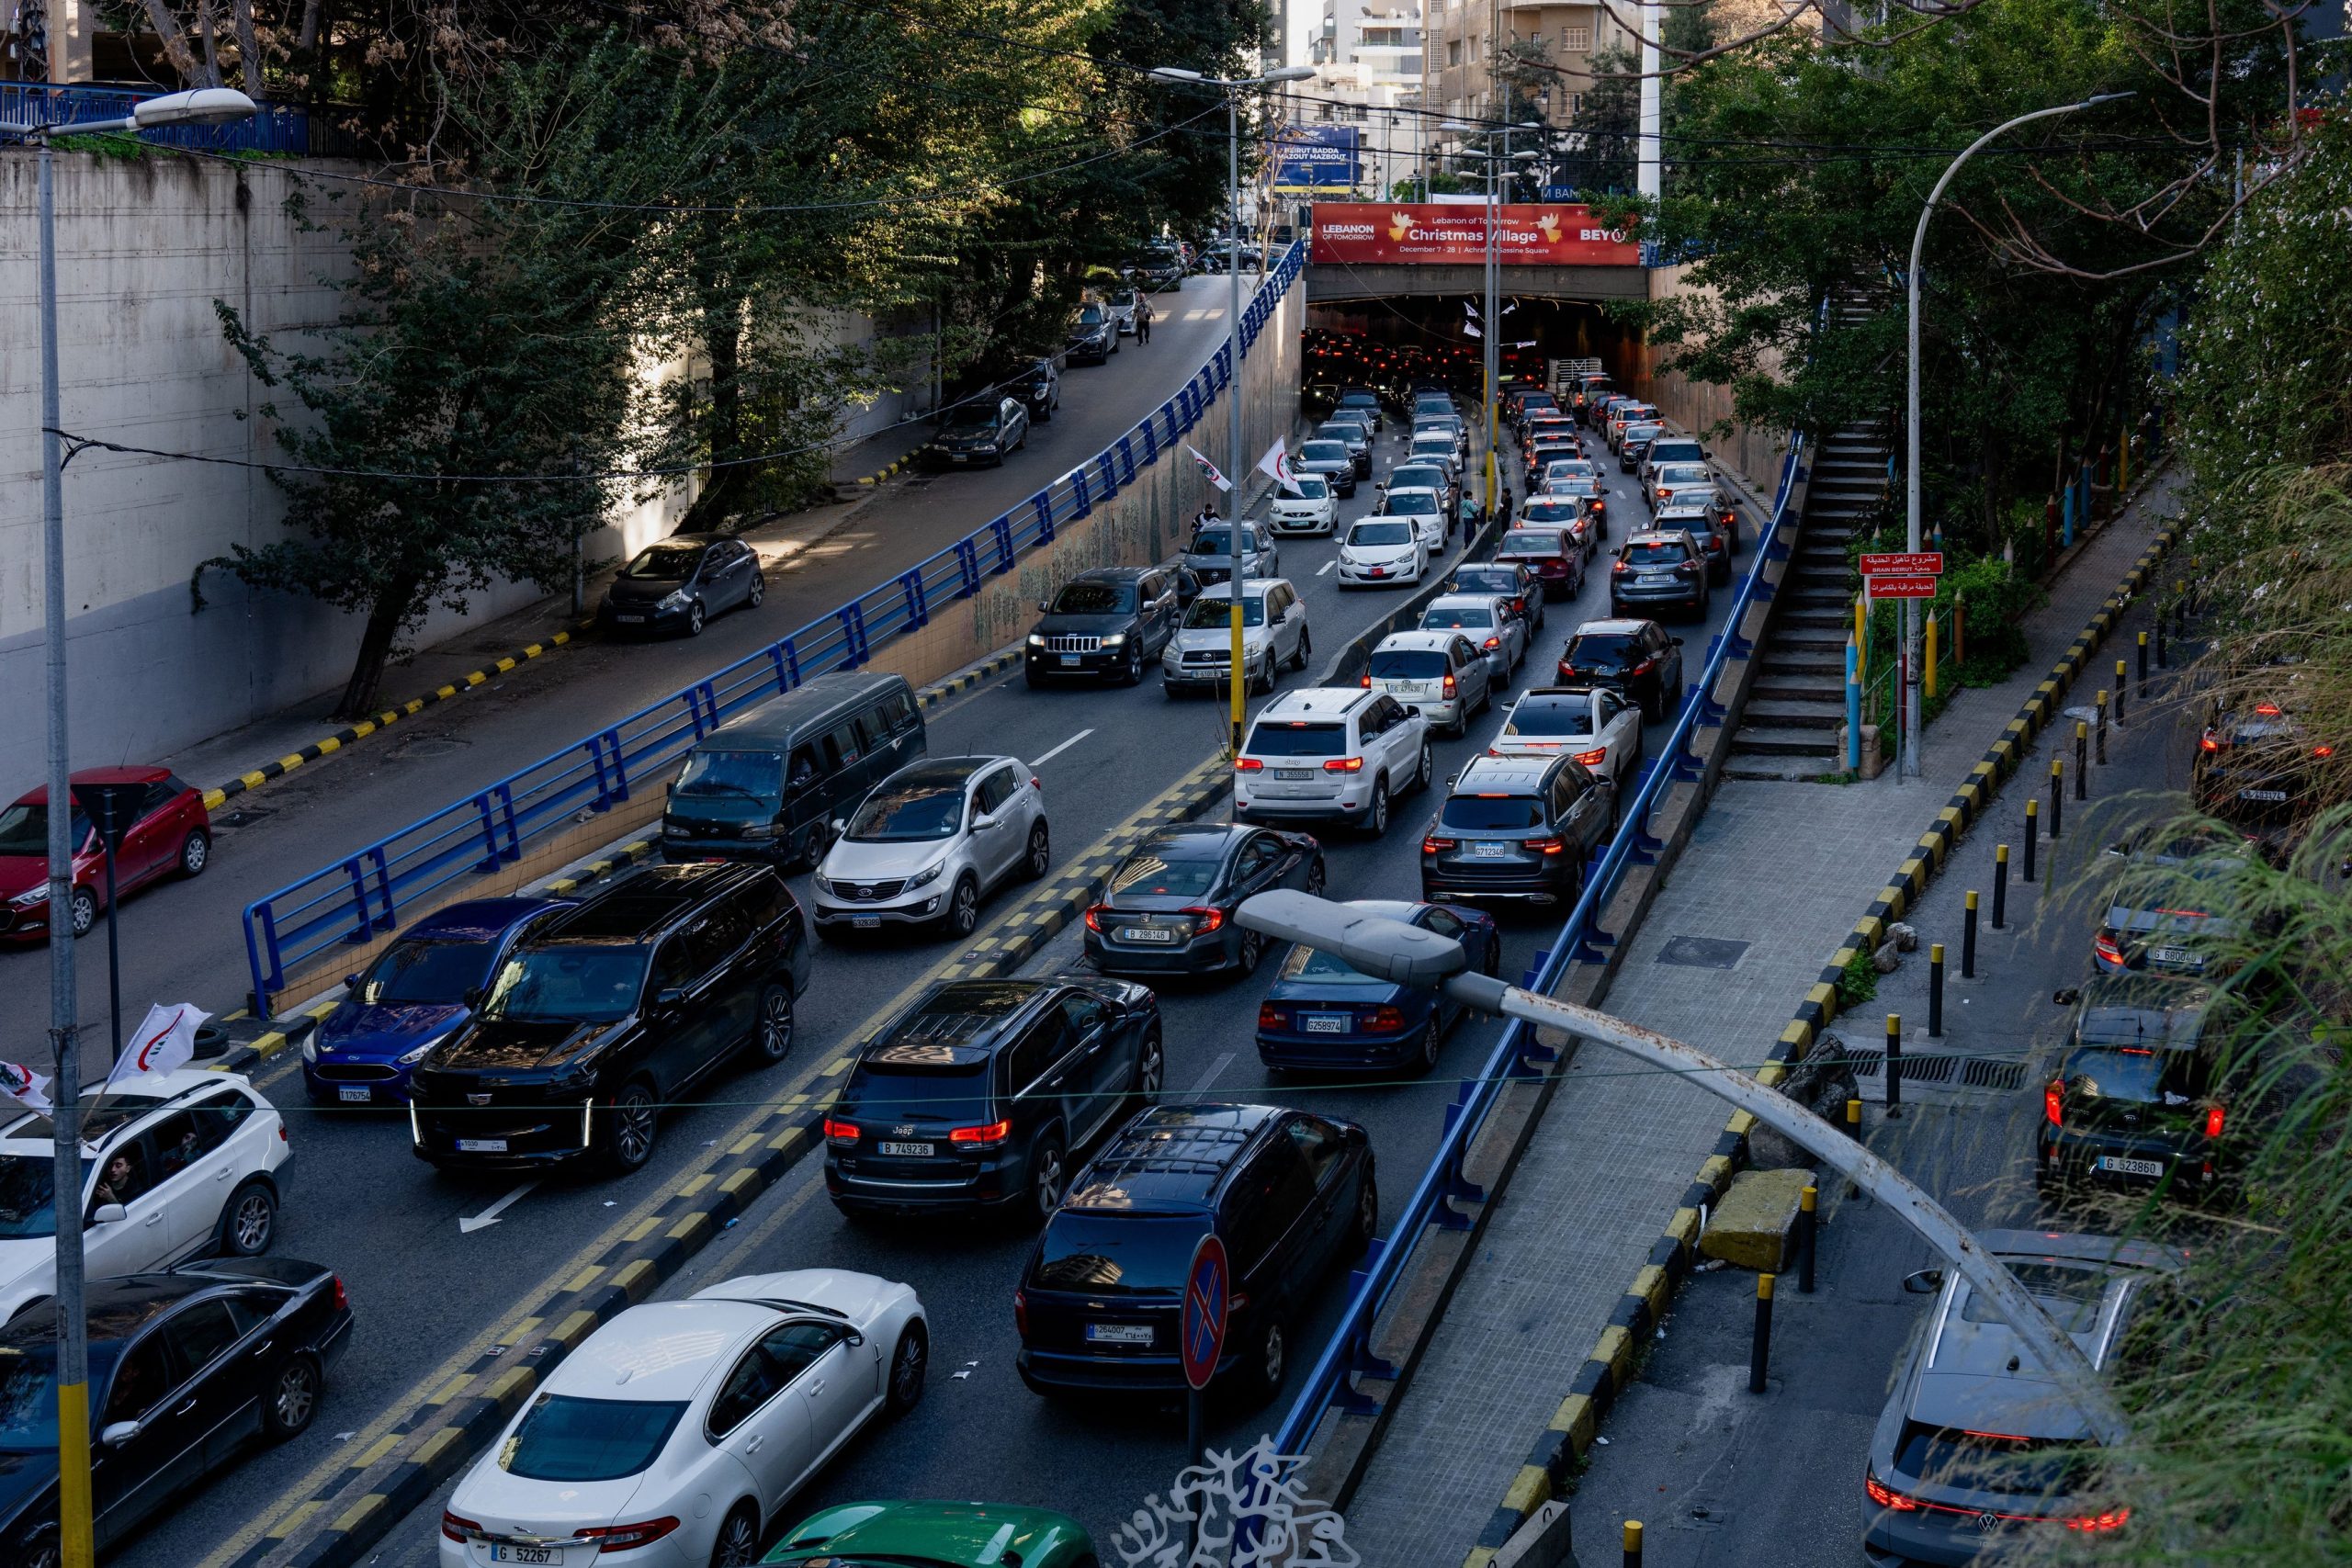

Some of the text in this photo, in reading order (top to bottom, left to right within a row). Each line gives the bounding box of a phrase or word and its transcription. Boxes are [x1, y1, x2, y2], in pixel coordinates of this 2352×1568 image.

[1555, 188, 1581, 198] BAN
[1323, 225, 1374, 233] LEBANON
[1409, 229, 1483, 240] Christmas
[1866, 555, 1890, 565] الحديقة
[1911, 555, 1937, 565] مشروع
[1309, 1021, 1340, 1030] G258974
[893, 1126, 913, 1136] Jeep
[885, 1144, 928, 1155] B 749236
[2107, 1158, 2156, 1174] G 523860
[500, 1547, 551, 1562] G 52267
